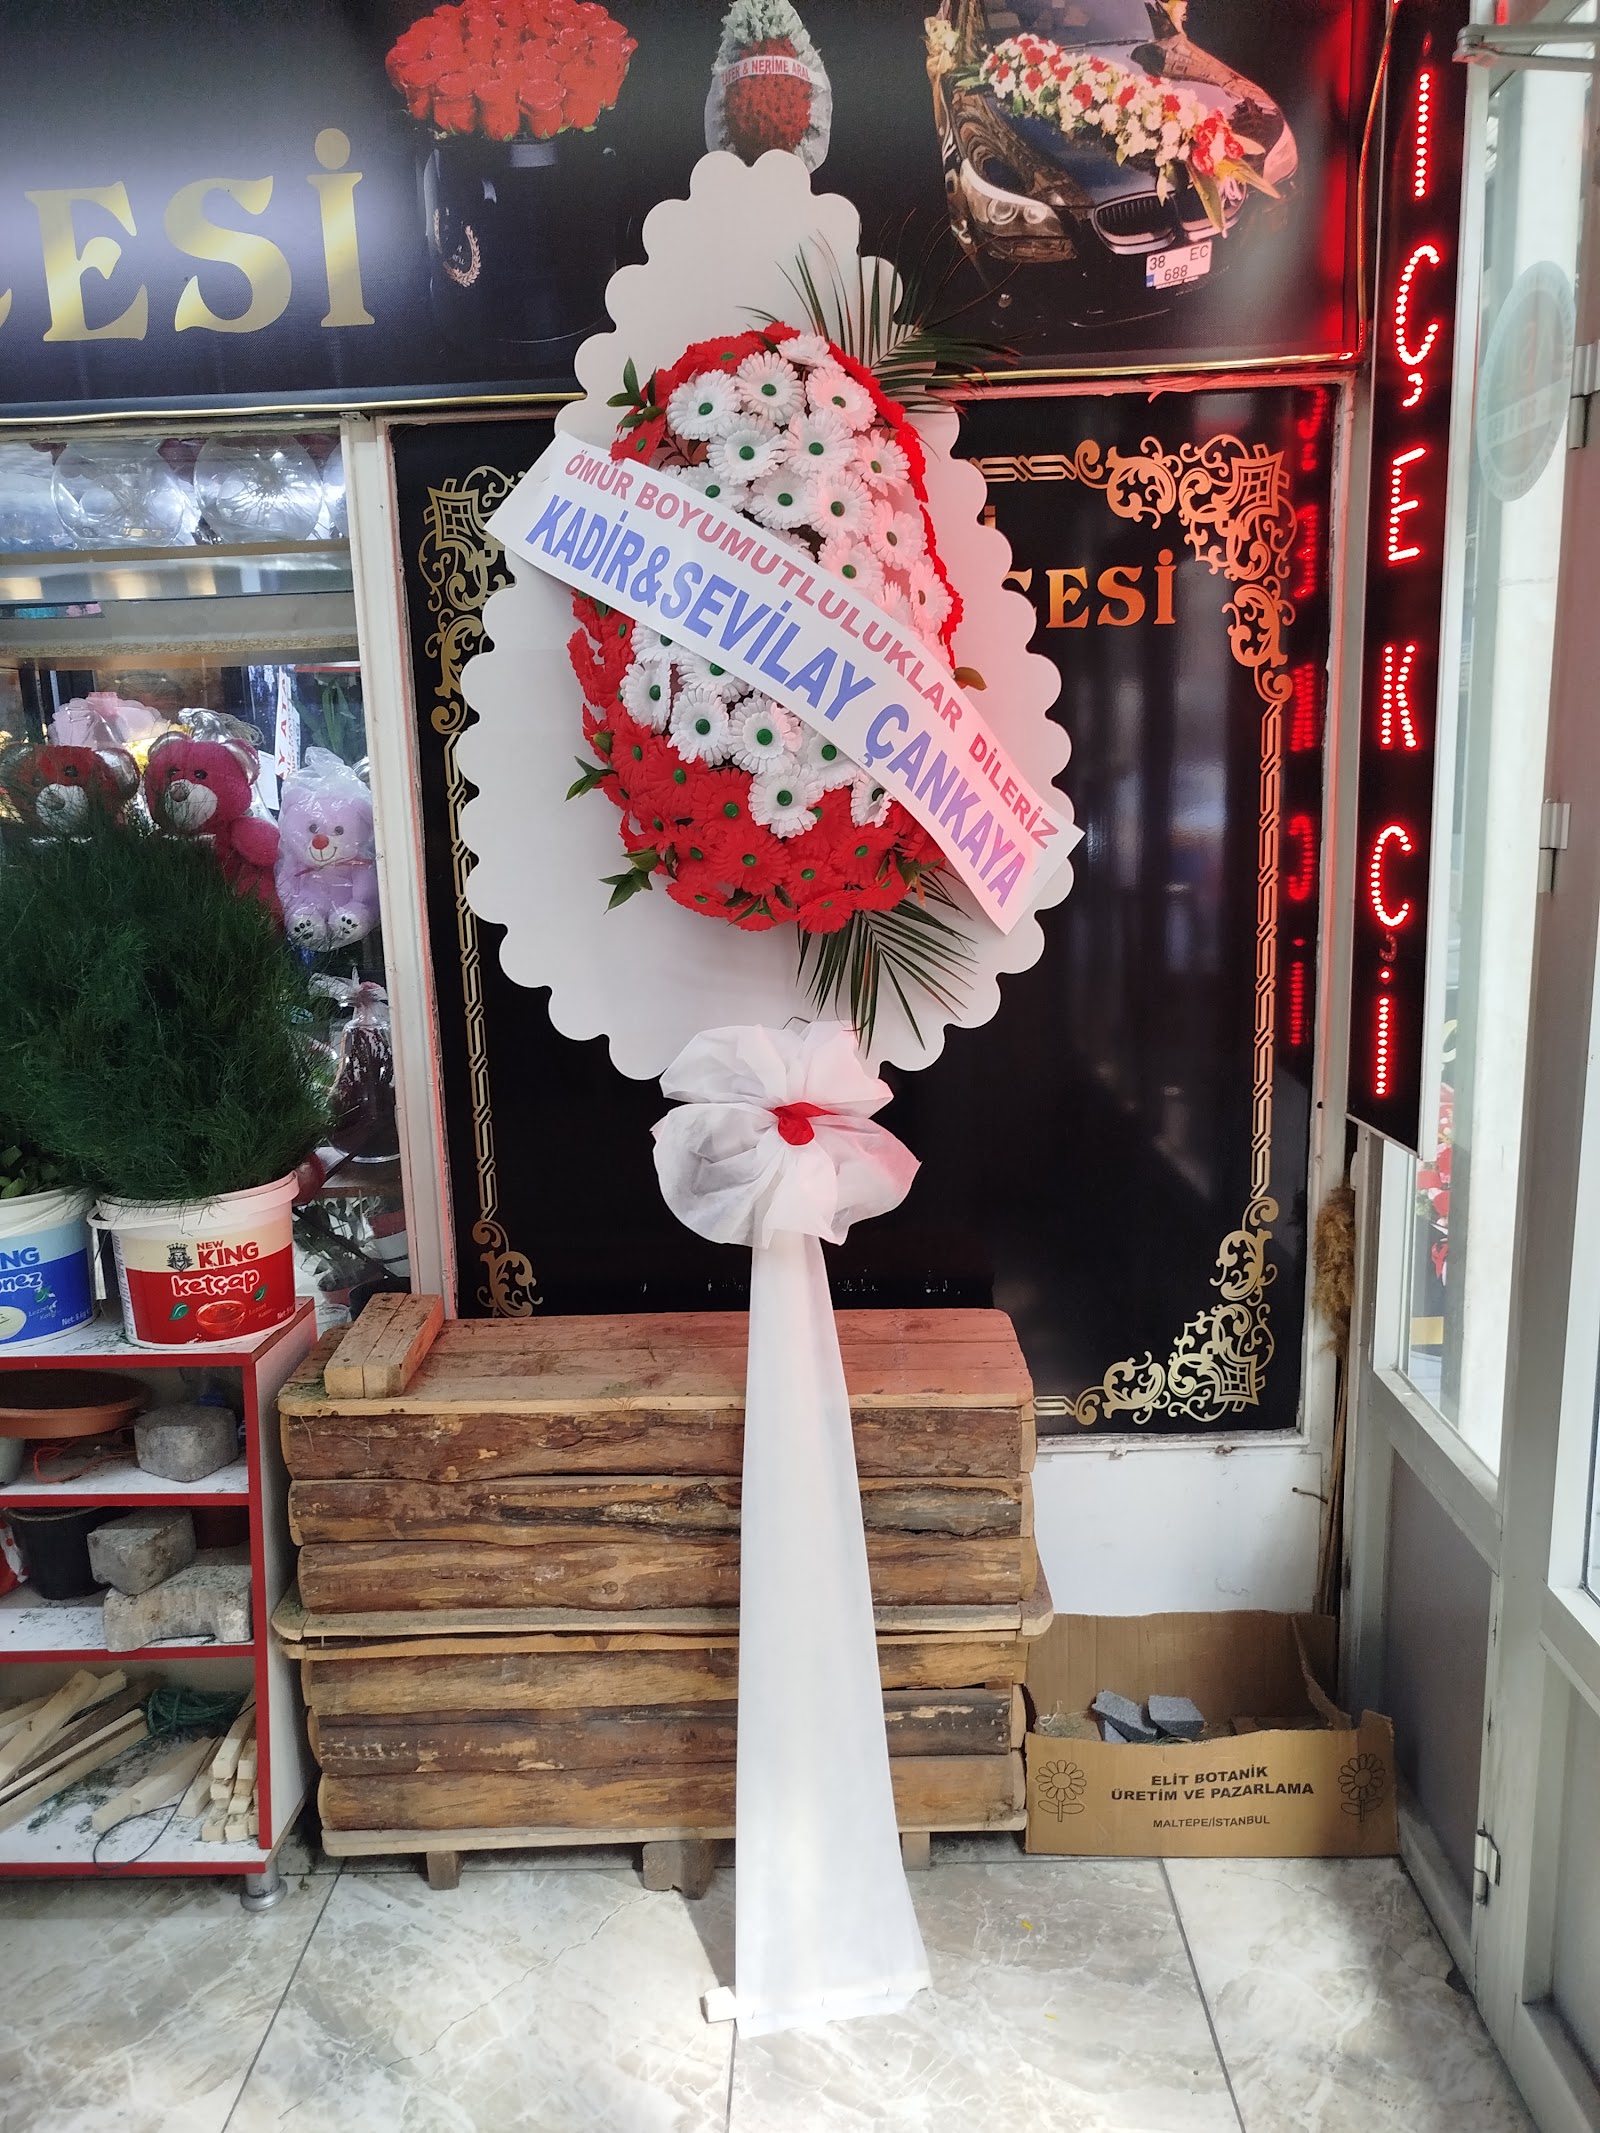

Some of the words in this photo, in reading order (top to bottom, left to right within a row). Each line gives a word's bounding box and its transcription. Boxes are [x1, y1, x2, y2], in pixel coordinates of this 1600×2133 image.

[742, 62, 749, 75] &
[751, 57, 790, 74] NERİME
[0, 128, 375, 342] ESİ
[1149, 255, 1166, 270] 38
[1190, 245, 1209, 261] EC
[1164, 265, 1188, 281] 688
[564, 450, 634, 500] ÖMÜR
[968, 733, 1059, 849] DİLERİZ
[858, 704, 1026, 908] ÇANKAYA
[196, 1240, 224, 1251] NEW
[197, 1241, 259, 1269] KING
[0, 1272, 43, 1293] nez
[171, 1270, 260, 1298] ketçap
[1151, 1772, 1189, 1786] ELİT
[1194, 1764, 1269, 1785] BOTANİK
[1111, 1788, 1178, 1801] ÜRETİM
[1184, 1788, 1205, 1799] VE
[1210, 1782, 1314, 1799] PAZARLAMA
[1152, 1814, 1271, 1829] MALTEPE/İSTANBUL
